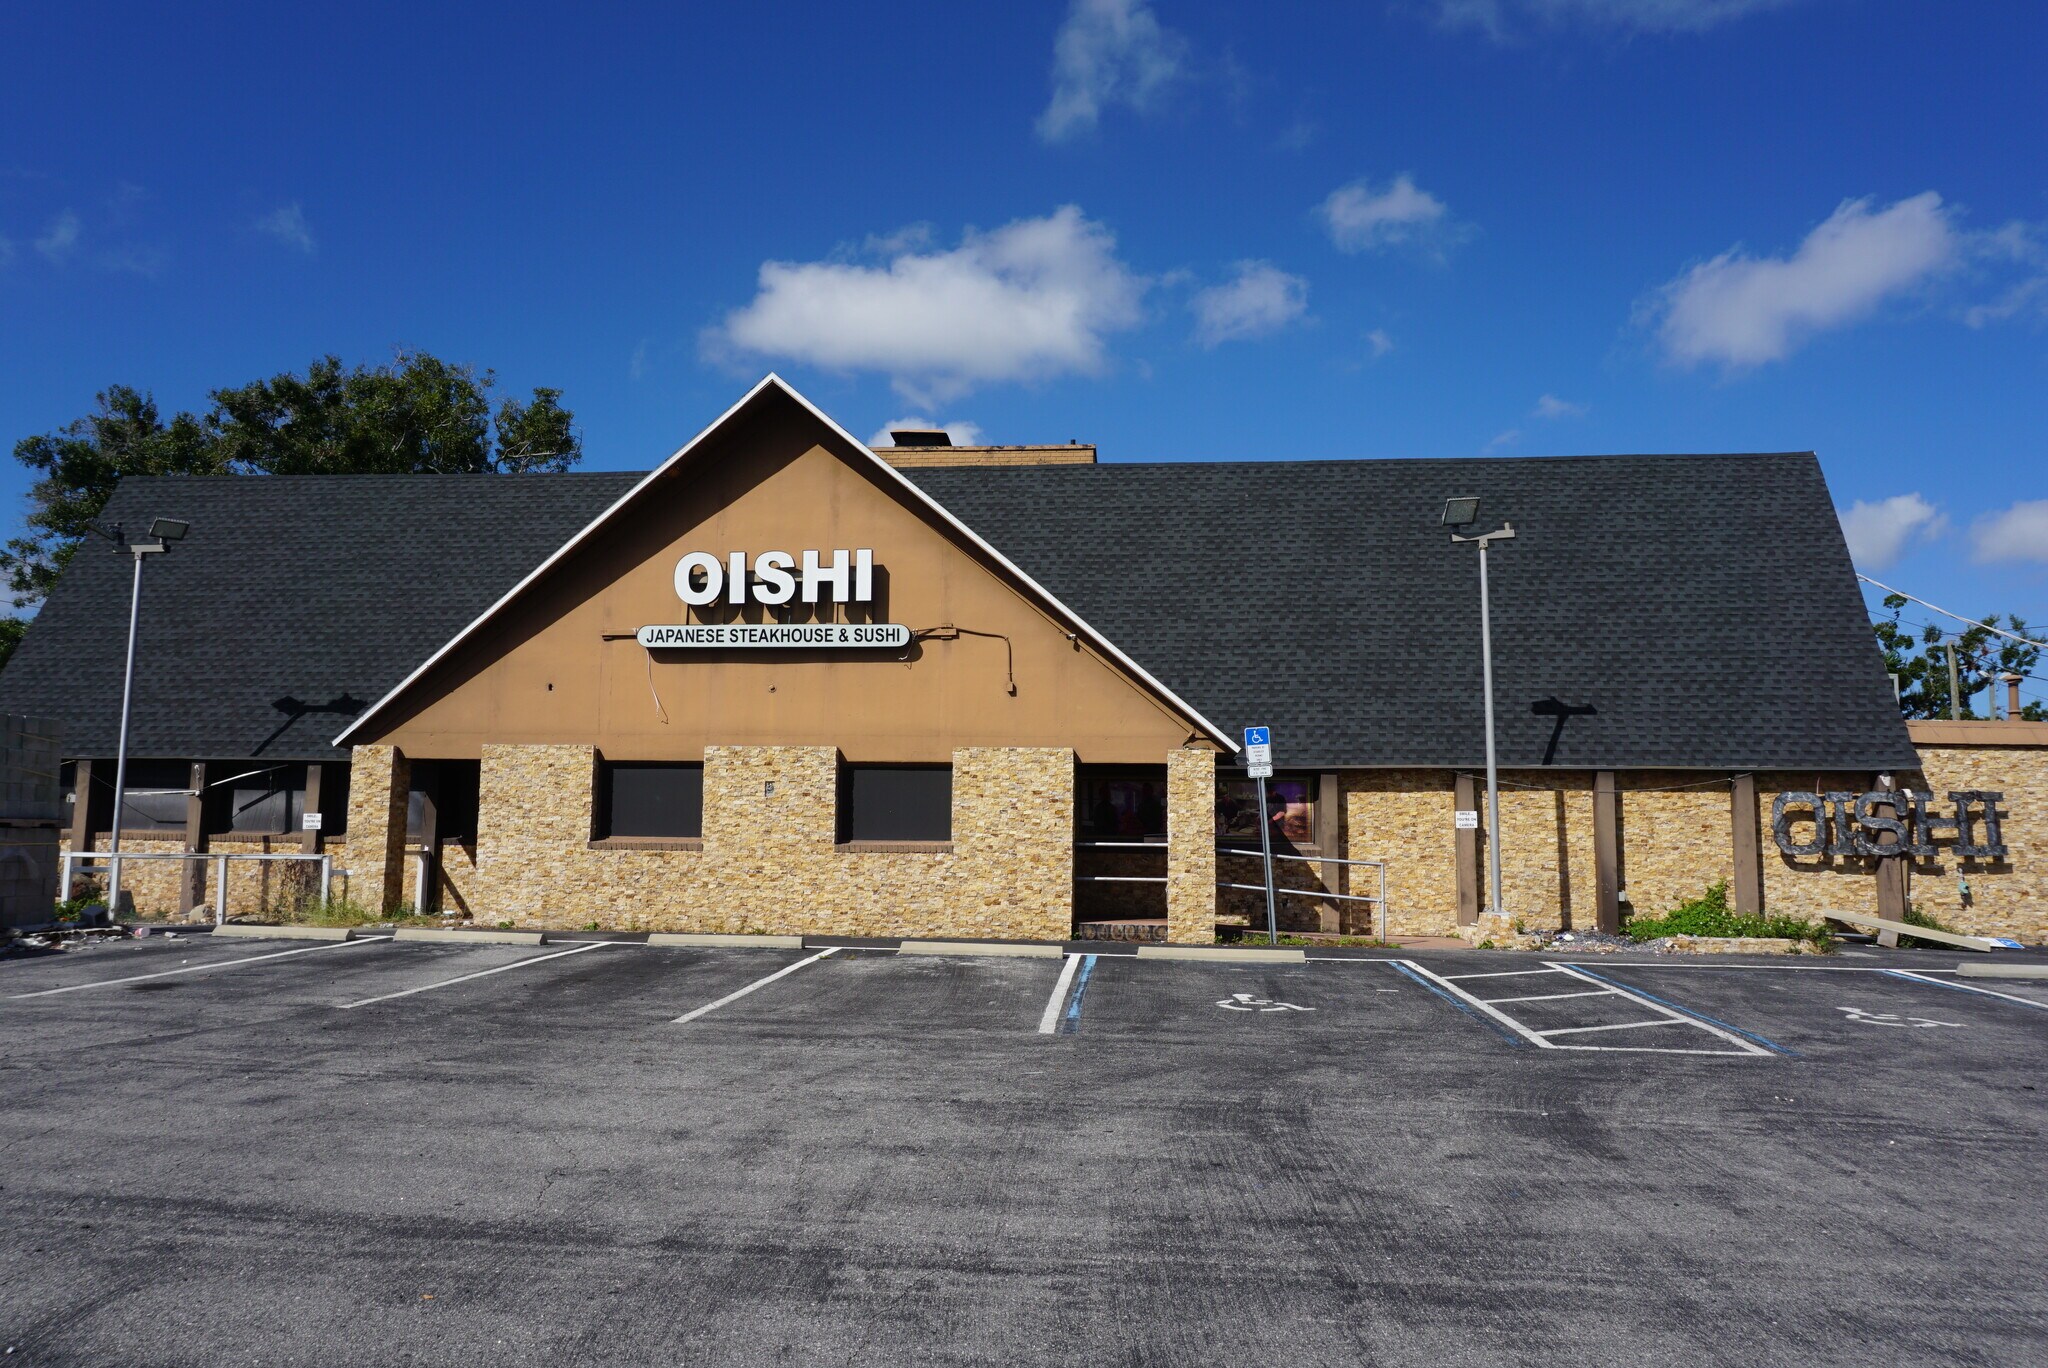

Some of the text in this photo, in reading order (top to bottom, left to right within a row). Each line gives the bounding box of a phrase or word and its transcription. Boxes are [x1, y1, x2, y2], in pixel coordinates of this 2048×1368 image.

[673, 548, 873, 606] OISHI
[646, 627, 900, 644] JAPANESE STEAKHOUSE & SUSHI
[1772, 791, 2009, 857] OISHI
